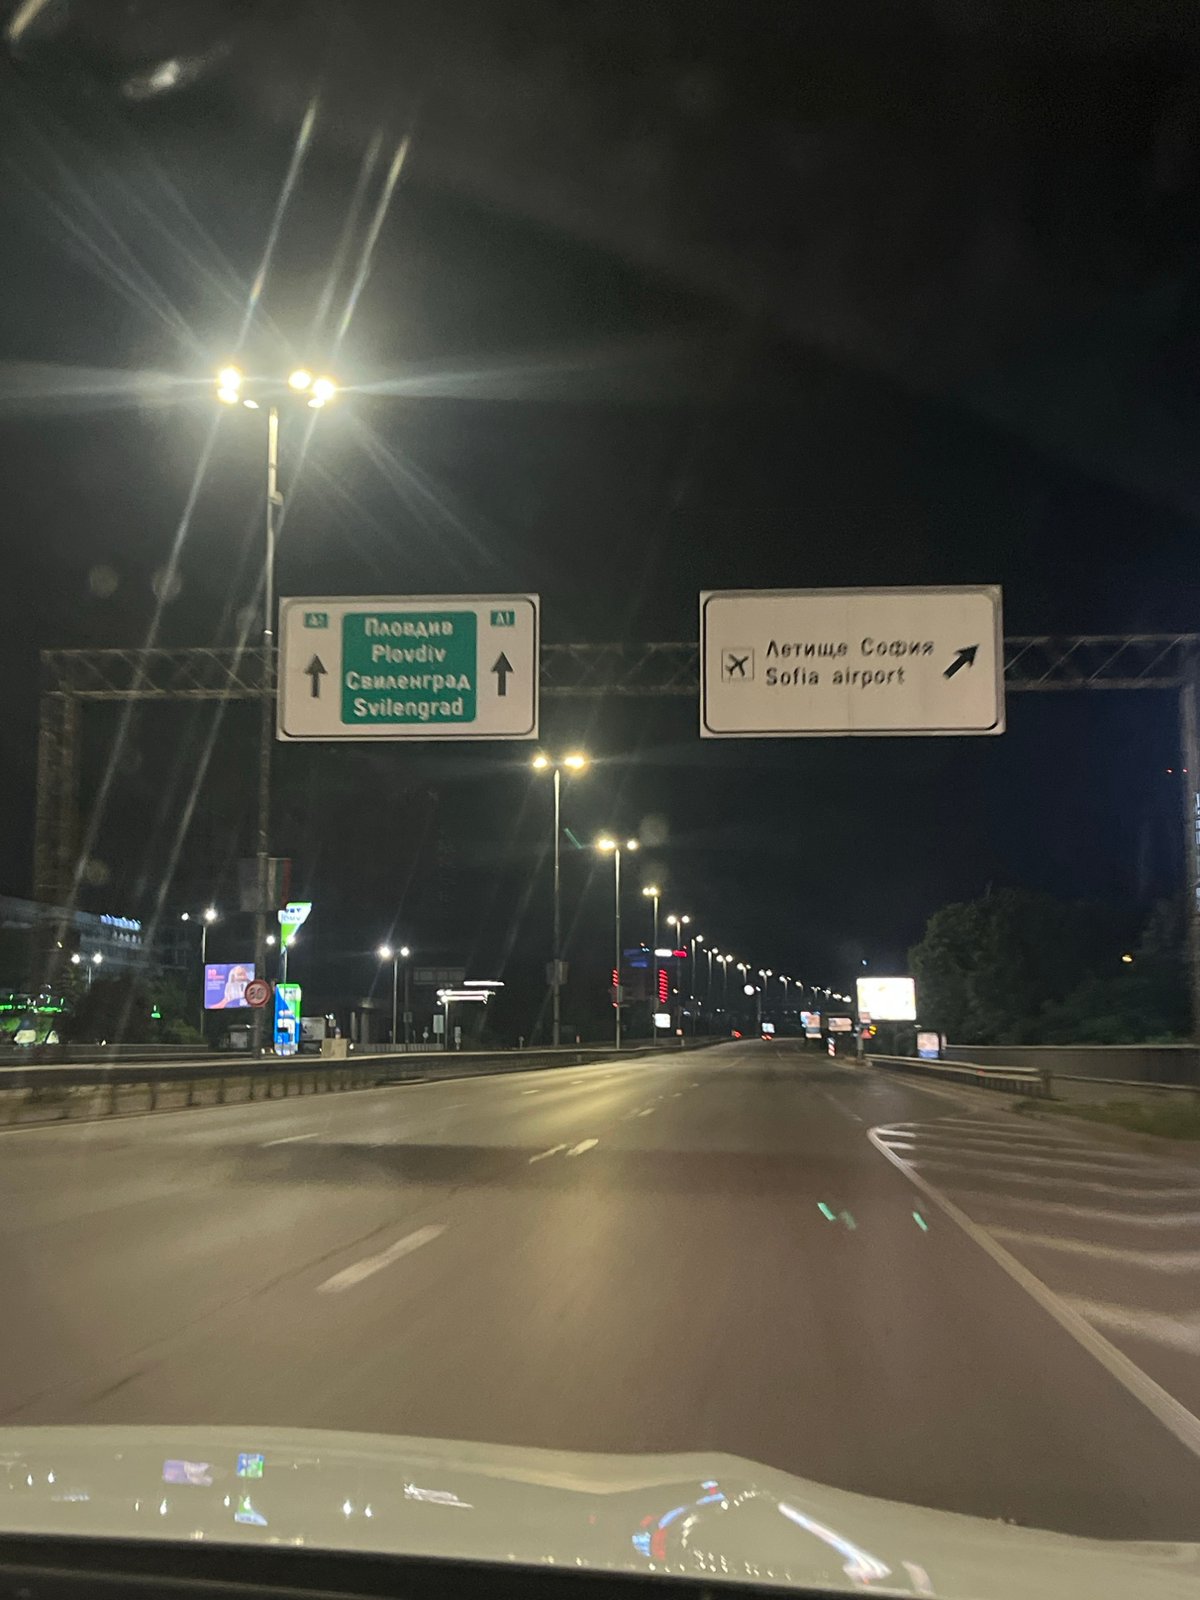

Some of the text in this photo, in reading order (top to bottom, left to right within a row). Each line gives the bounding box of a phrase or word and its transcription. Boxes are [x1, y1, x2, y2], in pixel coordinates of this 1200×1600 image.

[364, 617, 453, 638] Пловдив
[371, 644, 447, 663] Plovdiv
[766, 637, 935, 659] Летище София
[345, 671, 471, 694] Свиленград
[766, 666, 906, 689] Sofia airport
[353, 697, 464, 721] Svilengrad
